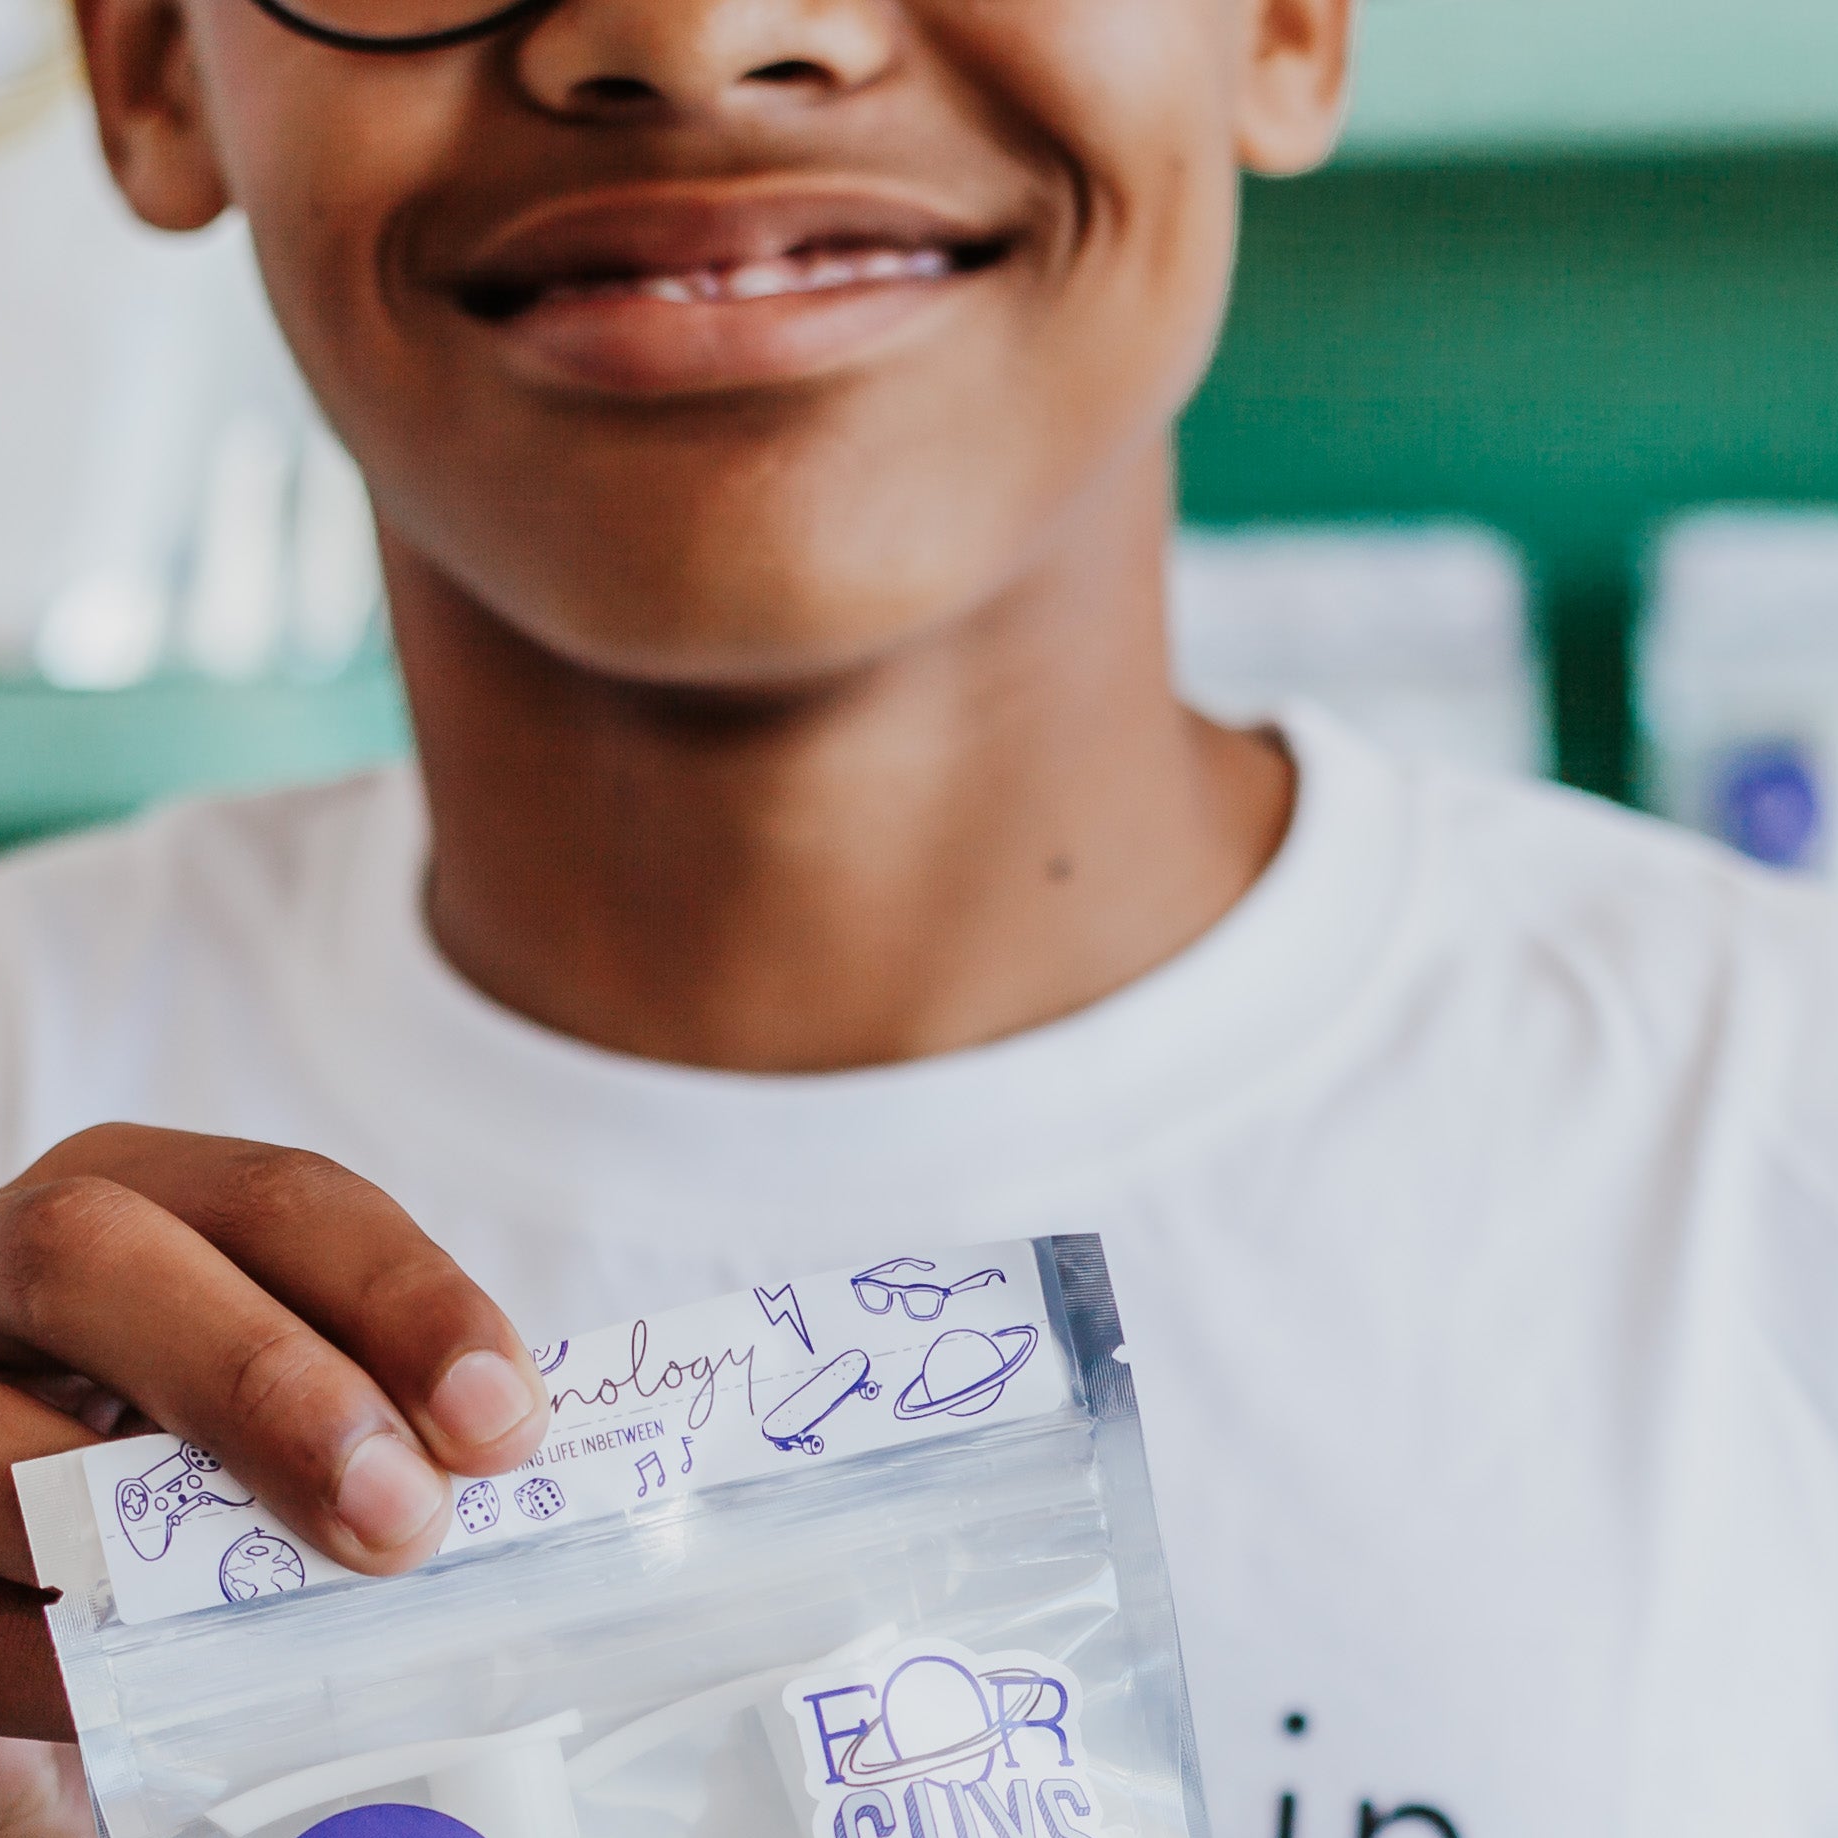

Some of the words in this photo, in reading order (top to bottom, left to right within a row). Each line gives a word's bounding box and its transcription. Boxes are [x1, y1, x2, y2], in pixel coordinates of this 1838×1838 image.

[549, 1319, 755, 1430] nology
[547, 1440, 579, 1463] LIFE
[580, 1419, 665, 1456] INBETWEEN
[803, 1655, 1074, 1790] FOR
